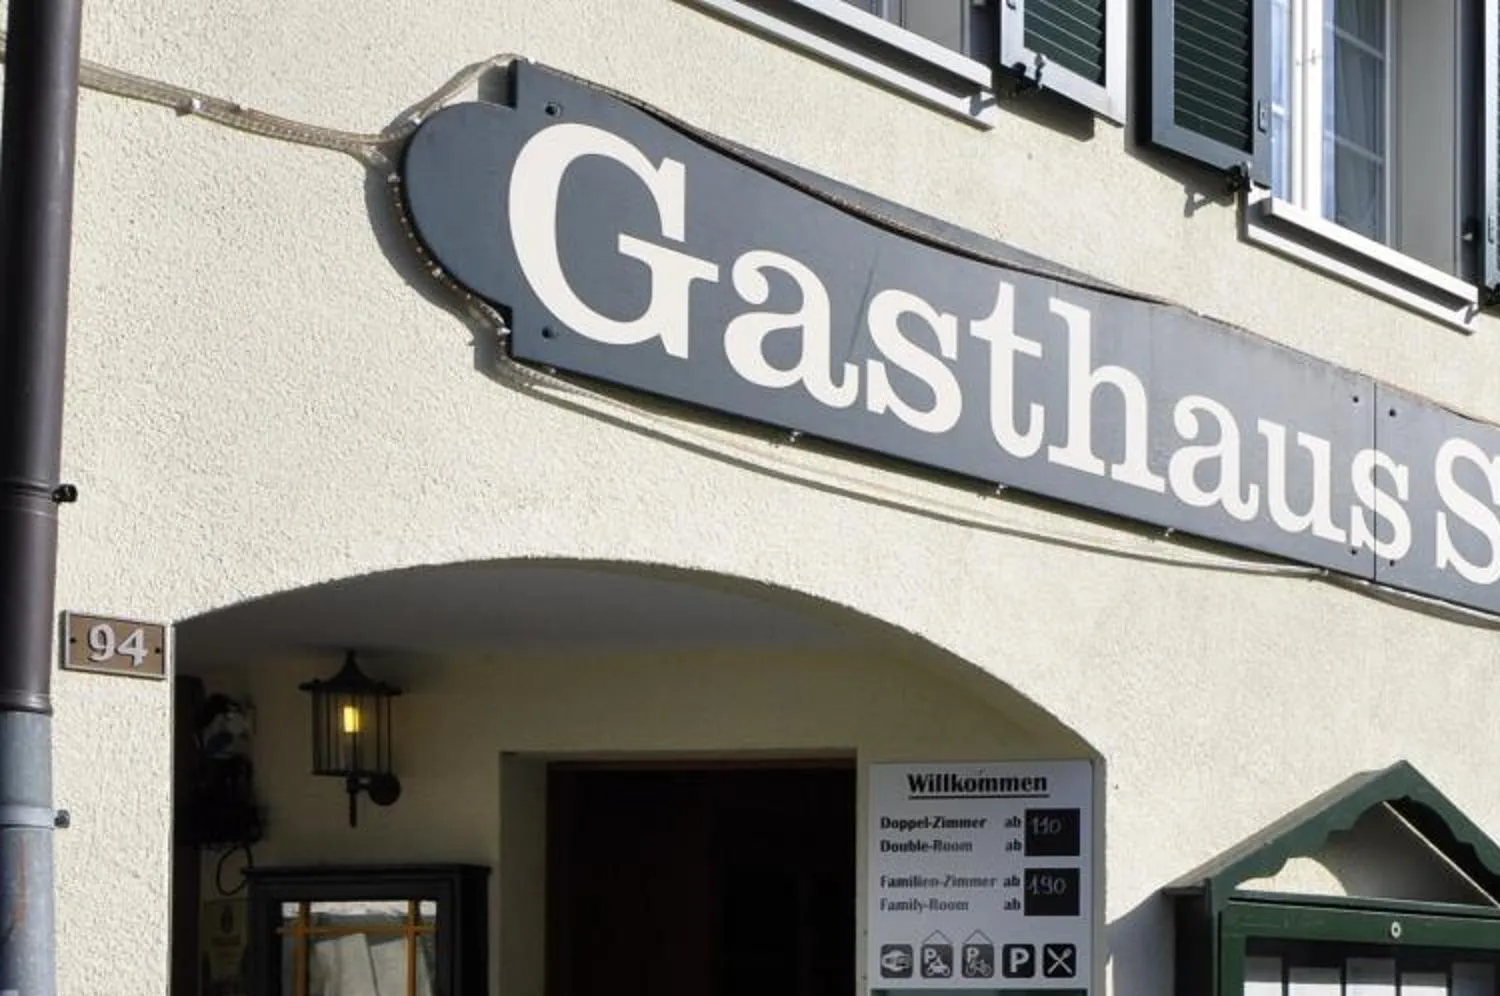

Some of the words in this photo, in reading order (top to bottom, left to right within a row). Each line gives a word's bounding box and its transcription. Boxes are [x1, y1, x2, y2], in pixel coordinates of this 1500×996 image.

[508, 123, 1412, 561] Gasthaus
[88, 624, 149, 667] 94
[907, 773, 1047, 793] Willkommen
[880, 816, 988, 831] Doppel-Zimmer
[1004, 816, 1021, 829] ab
[880, 839, 973, 853] Double-Room
[1005, 839, 1022, 852] ab
[880, 874, 997, 889] Familien-Zimmer
[1003, 875, 1021, 888] ab
[880, 897, 970, 914] Family-Room
[1003, 897, 1021, 911] ab
[1010, 948, 1030, 973] P
